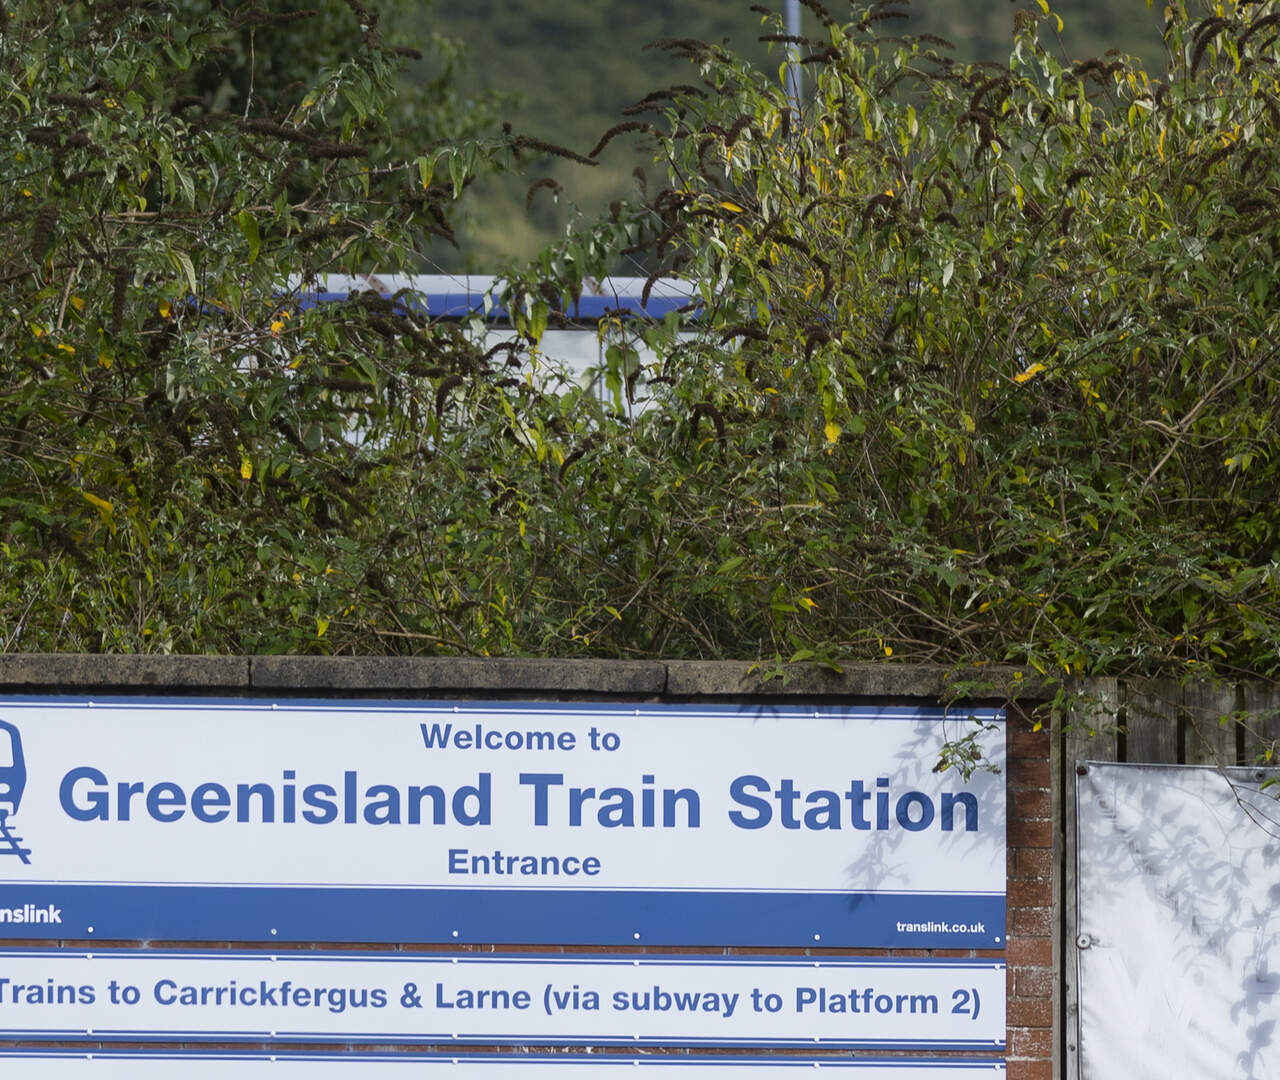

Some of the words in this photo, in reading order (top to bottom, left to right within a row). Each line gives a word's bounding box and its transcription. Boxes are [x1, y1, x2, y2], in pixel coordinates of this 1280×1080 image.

[419, 723, 577, 751] Welcome
[587, 727, 621, 752] to
[58, 766, 492, 827] Greenisland
[518, 772, 701, 829] Train
[727, 774, 979, 833] Station
[448, 848, 601, 876] Entrance
[896, 921, 985, 933] translink.co.uk
[107, 980, 141, 1006] to
[153, 979, 388, 1014] Carrickfergus
[399, 982, 423, 1009] &
[435, 982, 532, 1010] Larne
[543, 983, 600, 1016] (via
[612, 985, 740, 1018] subway
[750, 988, 783, 1013] to
[796, 987, 939, 1014] Platform
[951, 988, 981, 1021] 2)
